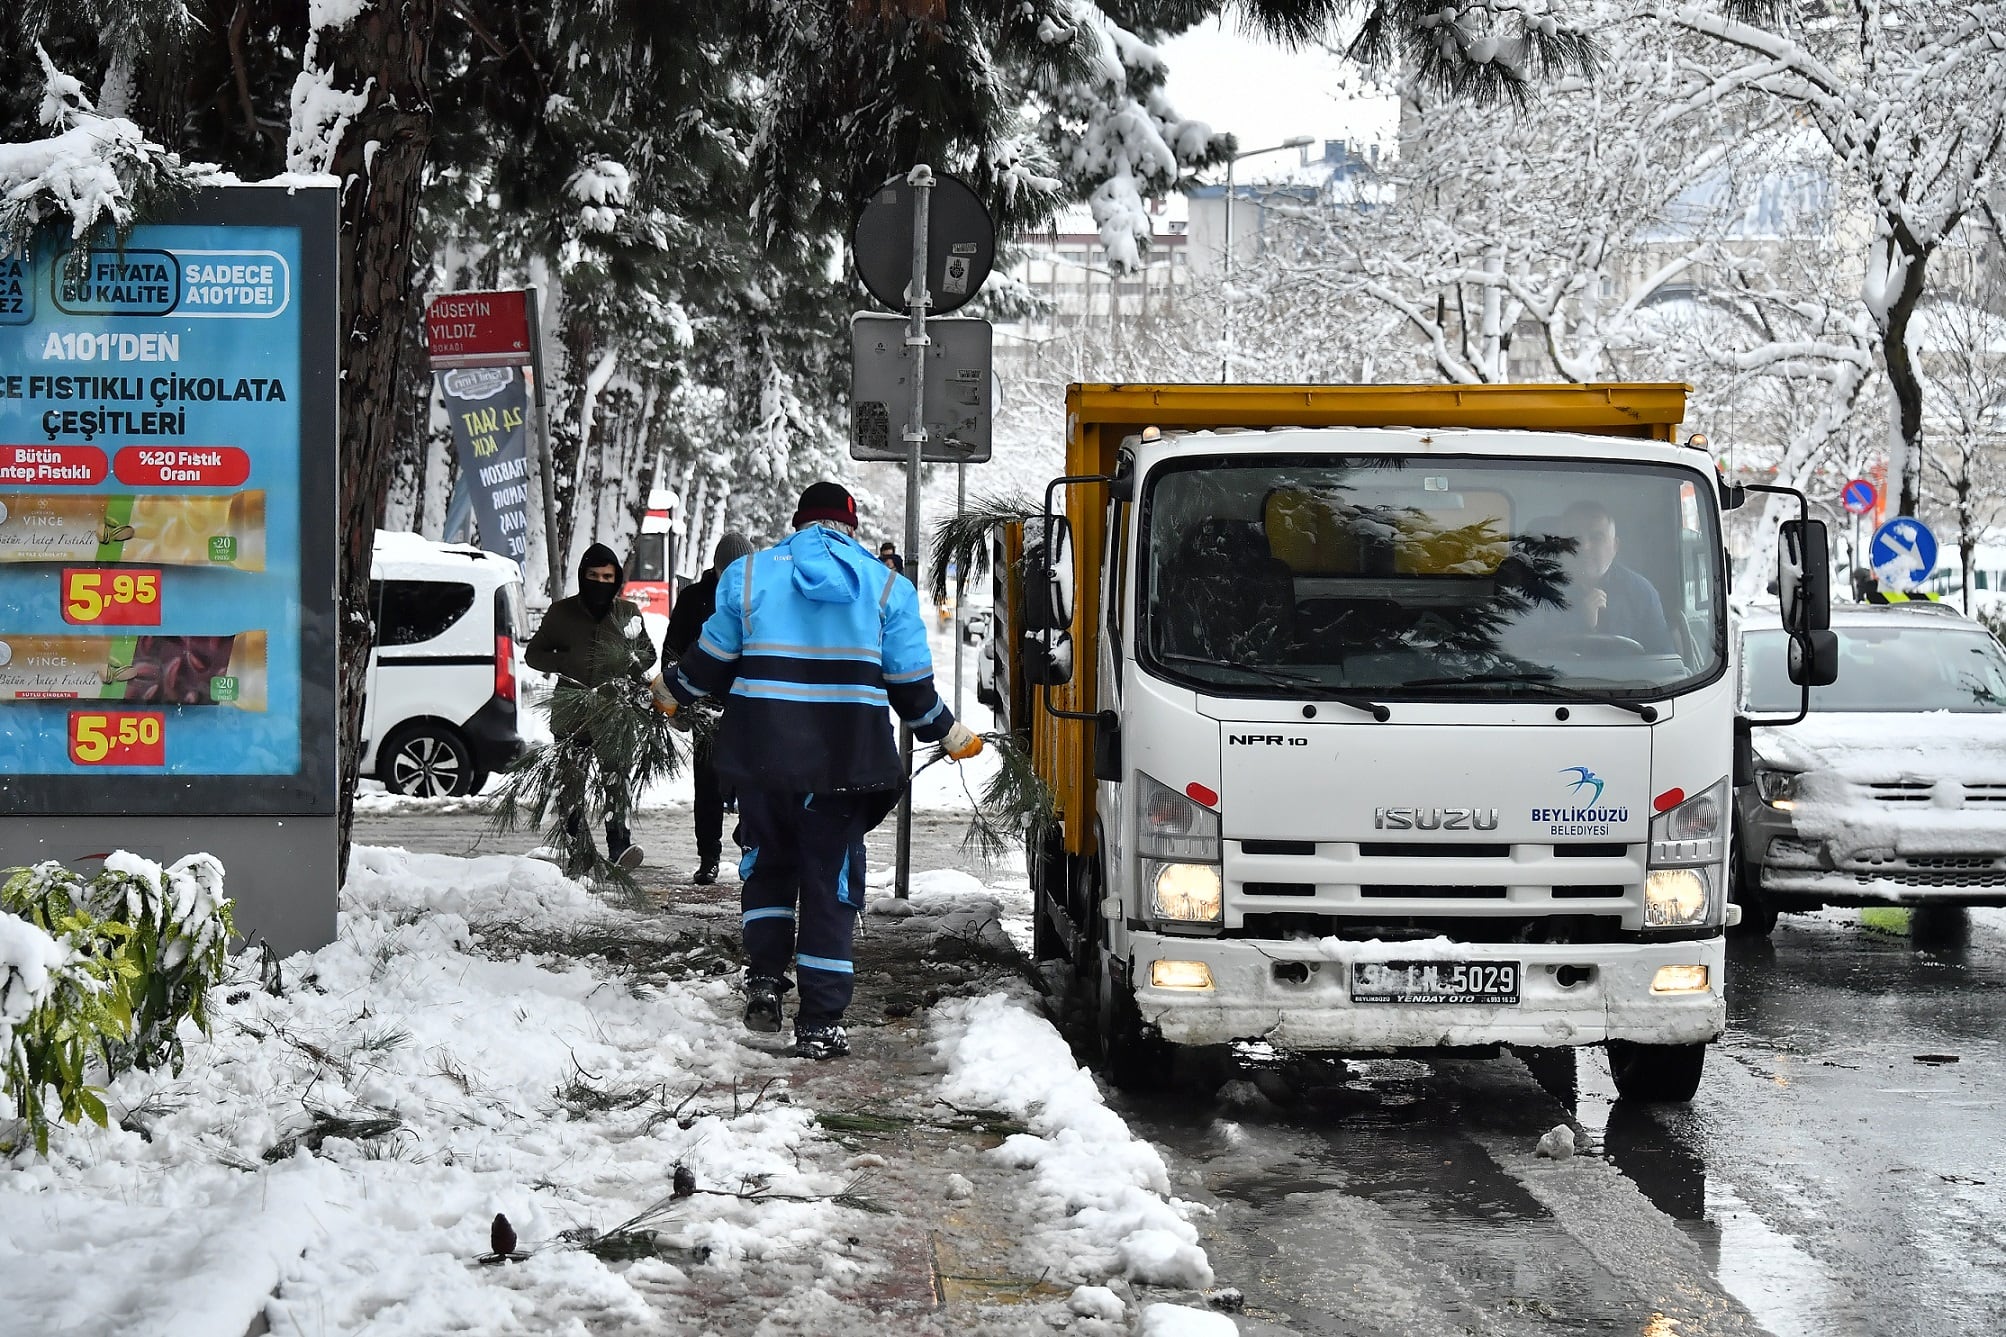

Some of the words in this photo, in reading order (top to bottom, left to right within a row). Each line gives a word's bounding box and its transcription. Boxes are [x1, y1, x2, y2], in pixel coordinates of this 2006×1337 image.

[186, 265, 273, 284] SADECE
[185, 286, 273, 305] A101'DE!
[430, 300, 491, 319] HÜSEYİN
[431, 323, 477, 340] YILDIZ
[42, 332, 179, 362] A101'DEN
[29, 375, 143, 400] FISTIKLI
[150, 371, 287, 408] ÇİKOLATA
[42, 405, 186, 441] ÇEŞİTLERİ
[15, 449, 62, 464] Bütün
[139, 450, 176, 466] %20
[178, 451, 222, 466] Fıstık
[0, 465, 36, 482] ntep
[38, 464, 91, 479] Fıstıklı
[160, 466, 201, 481] Oranı
[67, 573, 157, 622] 5,95
[75, 715, 160, 763] 5,50
[1229, 734, 1284, 746] NPR
[1287, 737, 1308, 746] 10
[1374, 806, 1499, 831] ISUZU
[1531, 805, 1629, 823] BEYLİKDÜZÜ
[1453, 966, 1515, 994] 5029
[1396, 994, 1447, 1004] YENDAY
[1448, 994, 1476, 1004] OTO
